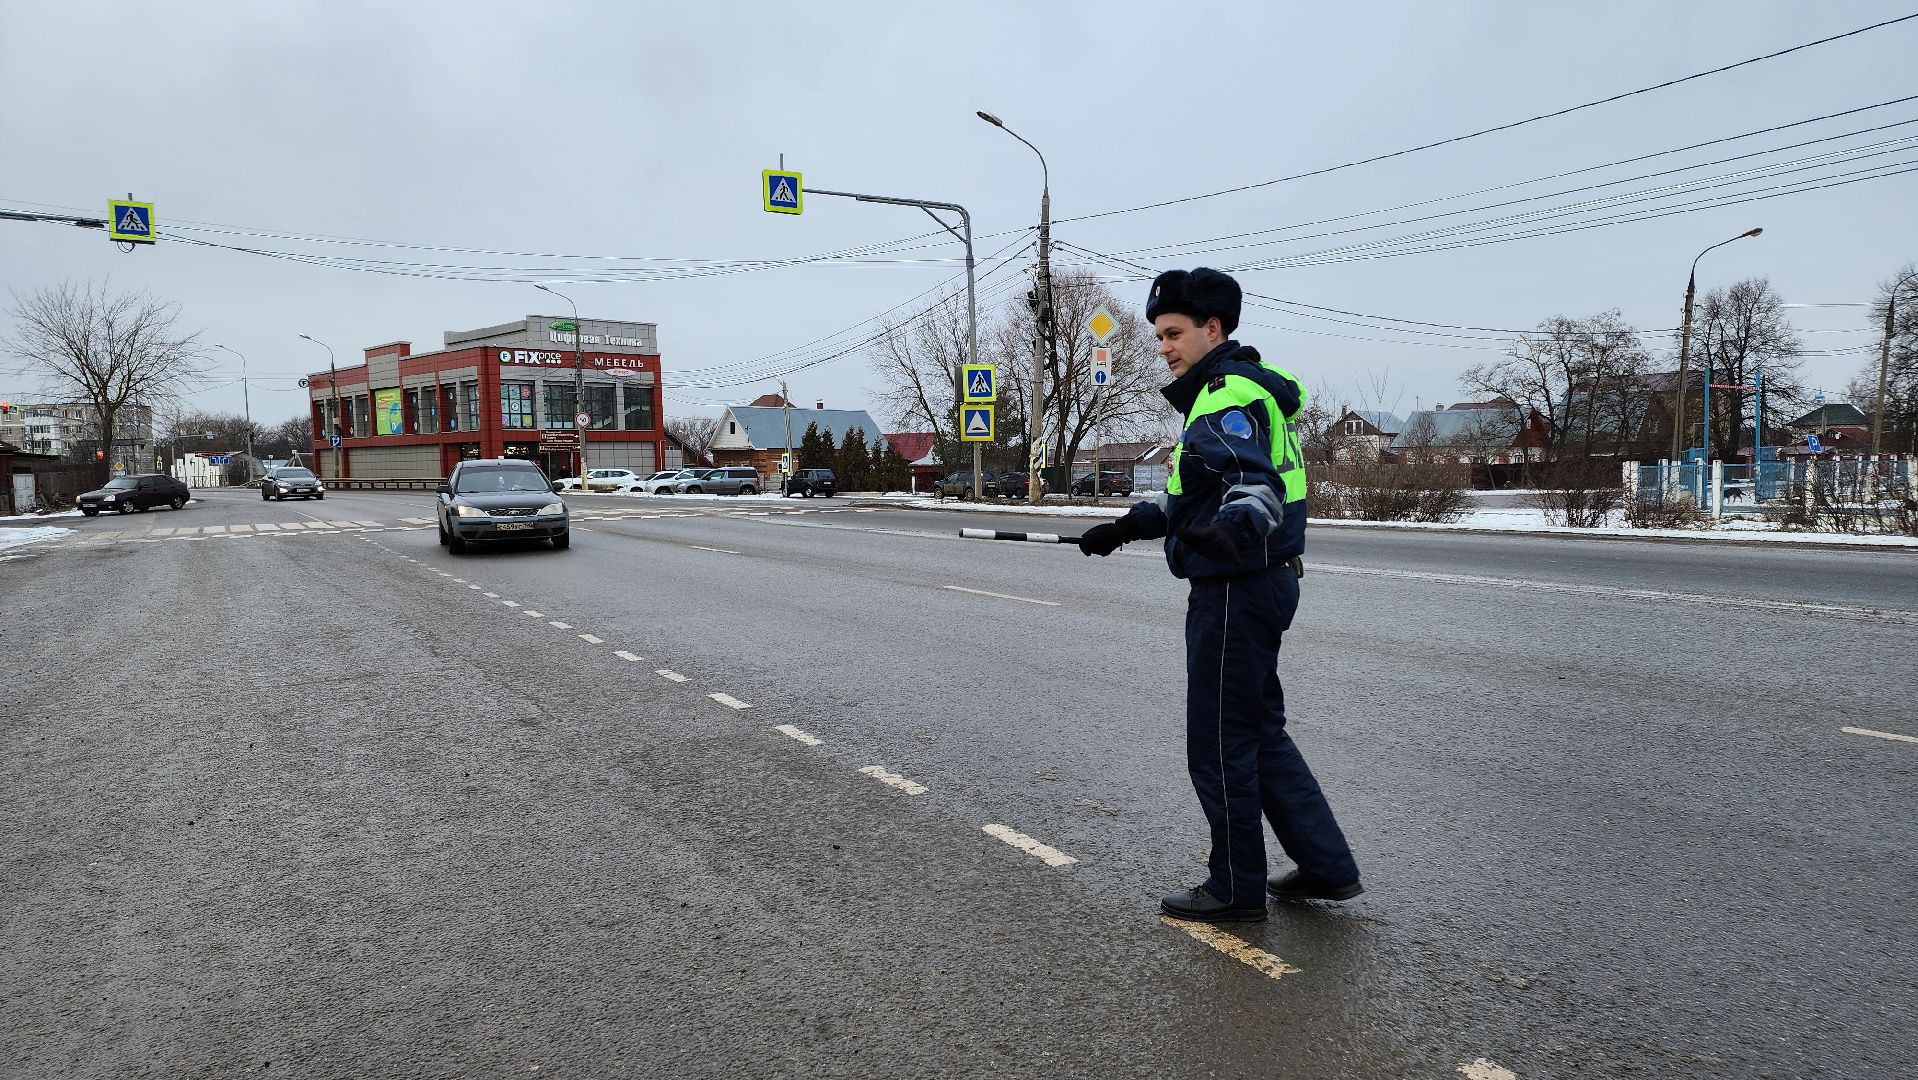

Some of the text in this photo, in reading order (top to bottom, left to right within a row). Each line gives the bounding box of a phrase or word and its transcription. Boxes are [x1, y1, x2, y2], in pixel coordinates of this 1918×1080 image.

[549, 331, 642, 347] Цифровая Техника
[594, 357, 644, 368] МЕБЕЛЬ
